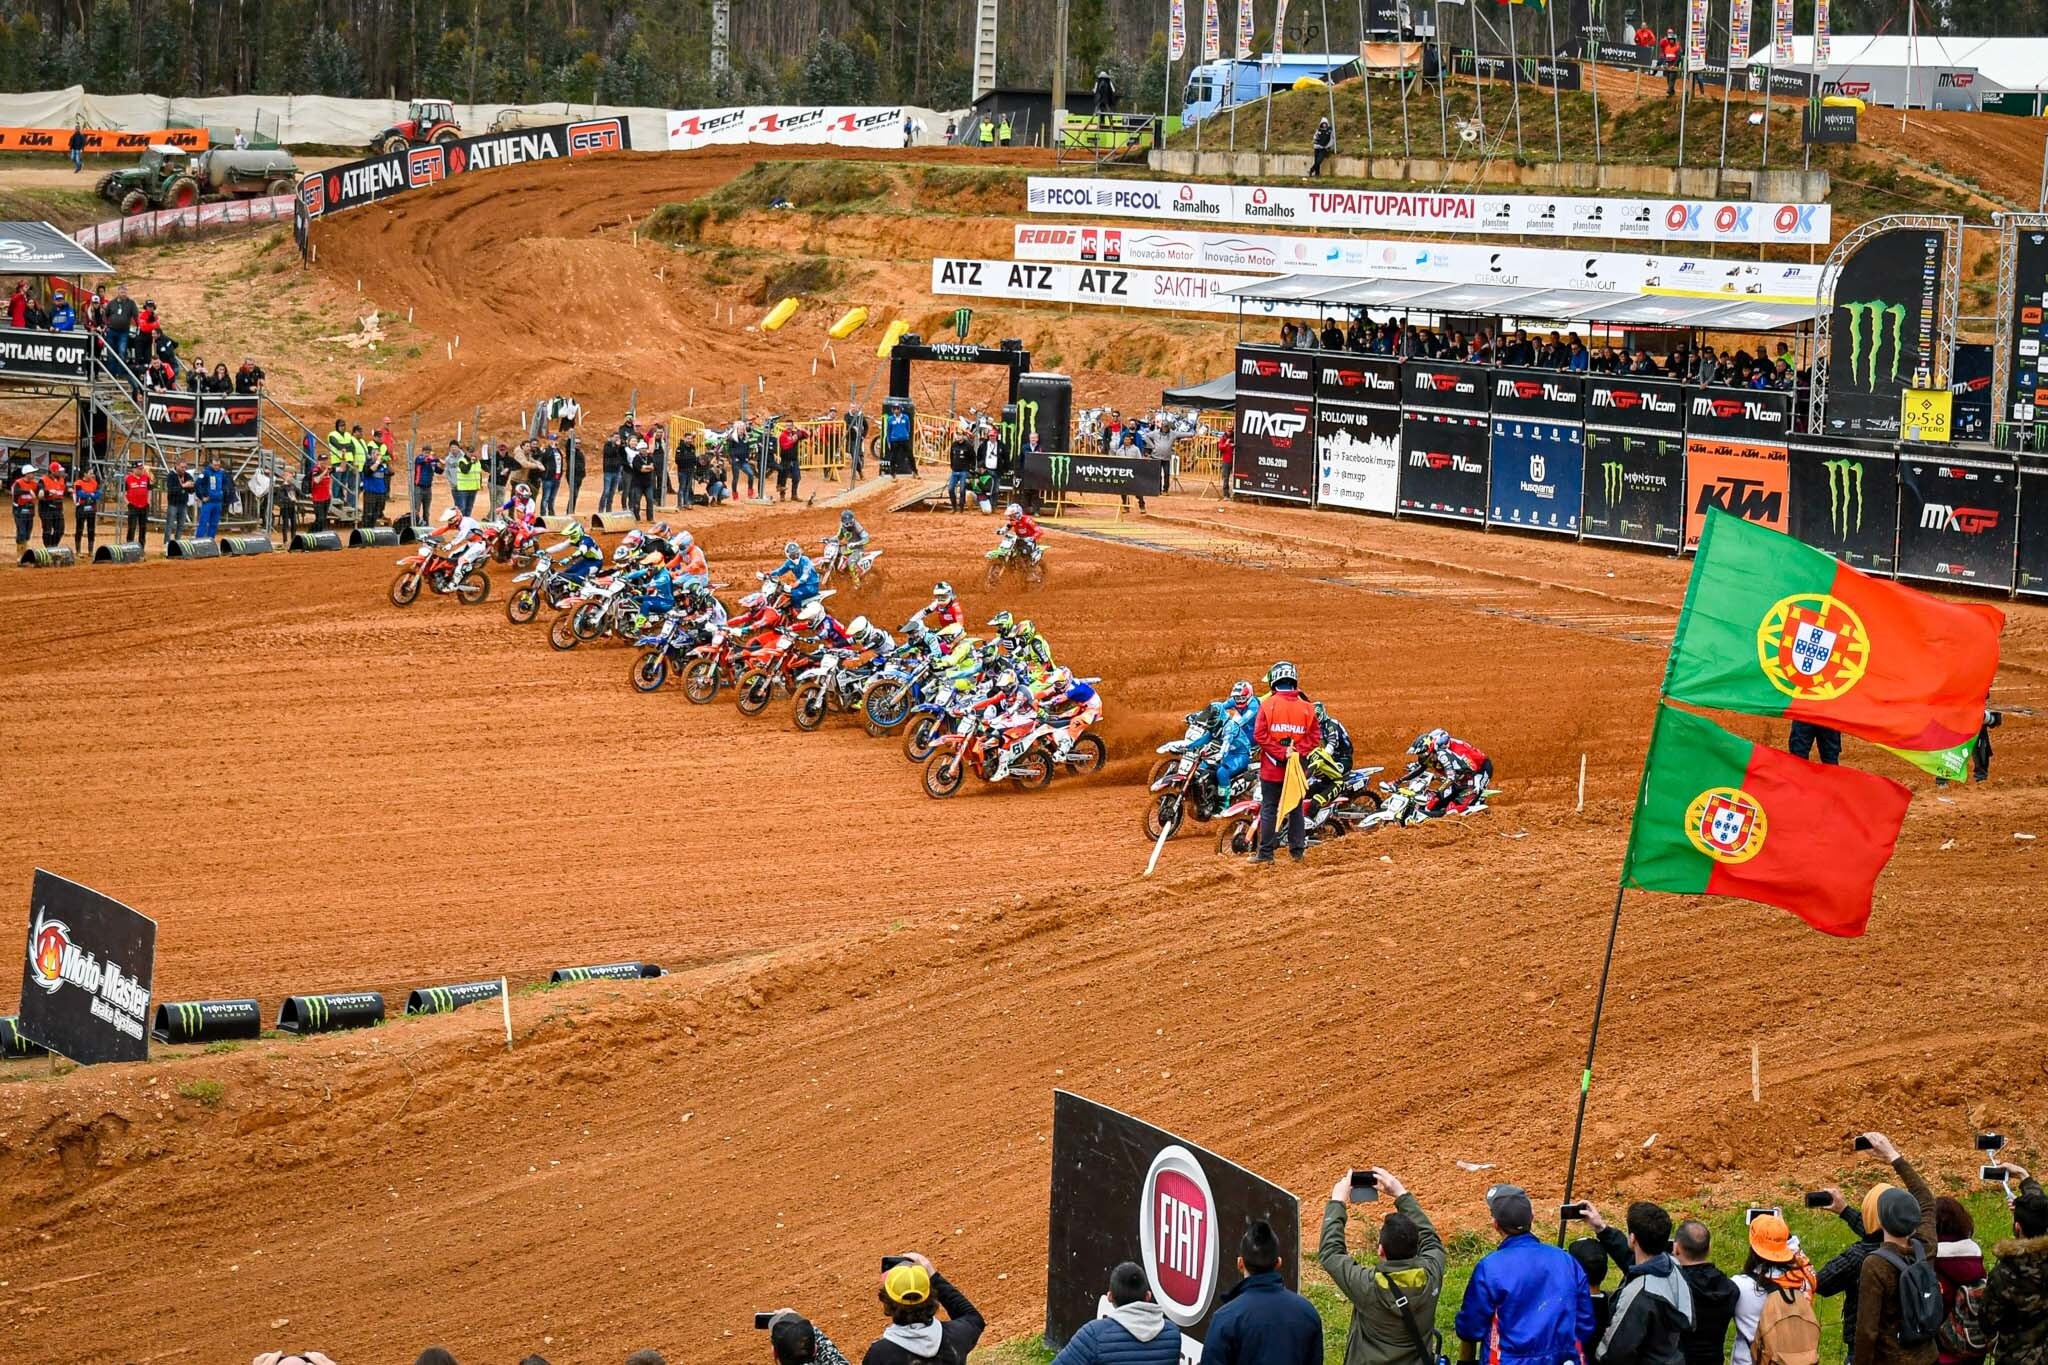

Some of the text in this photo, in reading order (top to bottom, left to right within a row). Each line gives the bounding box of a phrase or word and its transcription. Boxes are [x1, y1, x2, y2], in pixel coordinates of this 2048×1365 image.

[1939, 73, 1974, 87] MXGP
[1825, 114, 1854, 125] MONSTER
[19, 132, 53, 146] KTM
[116, 134, 151, 147] KTM
[165, 133, 198, 146] KTM
[574, 130, 616, 149] GET
[469, 132, 559, 171] ATHENA
[410, 156, 441, 175] GET
[342, 159, 404, 200] ATHENA
[1048, 188, 1093, 205] PECOL
[1115, 191, 1161, 209] PECOL
[1173, 199, 1220, 214] Ramalhos
[1245, 203, 1295, 218] Ramalhos
[1481, 217, 1509, 229] planstone
[1665, 203, 1703, 231] OK
[1714, 205, 1753, 232] OK
[1774, 205, 1816, 234] OK
[1526, 219, 1554, 231] planstone
[1572, 221, 1601, 231] planstone
[1619, 222, 1649, 232] planstone
[1082, 238, 1097, 251] MR
[1104, 240, 1120, 253] MR
[1129, 247, 1166, 260] Inovação
[1167, 250, 1194, 260] Motor
[1204, 253, 1245, 265] Inovação
[1247, 255, 1276, 266] Motor
[941, 261, 982, 286] ATZ
[1008, 264, 1053, 290] ATZ
[1078, 268, 1128, 295] ATZ
[1154, 274, 1207, 298] SAKTHI
[55, 346, 85, 364] OUT
[932, 342, 979, 356] MONSTER
[1952, 376, 1991, 396] MXGP
[148, 403, 195, 424] MXGP
[203, 407, 258, 426] MXGP
[1321, 411, 1368, 426] FOLLOW US
[1241, 409, 1307, 440] MXGP
[1689, 443, 1707, 454] KTM
[1714, 446, 1733, 456] KTM
[1741, 448, 1760, 459] KTM
[1767, 451, 1786, 461] KTM
[1341, 451, 1396, 469] Facebook/mxgp
[1076, 464, 1135, 479] MONSTER
[1341, 470, 1367, 483] @mxgp
[1520, 480, 1555, 494] Husqvarna
[1623, 472, 1667, 487] MONSTER
[1340, 488, 1365, 501] @mxgp
[1695, 476, 1782, 523] KTM
[1920, 503, 2000, 534] MXGP
[1012, 744, 1025, 757] 61
[591, 964, 637, 977] MONSTER
[60, 942, 150, 1022] Moto-Master
[450, 983, 498, 997] MONSTER
[327, 995, 376, 1006] MONSTER
[202, 1003, 254, 1014] MONSTER
[91, 996, 143, 1040] Brake Systems
[1159, 1192, 1204, 1280] FIAT
